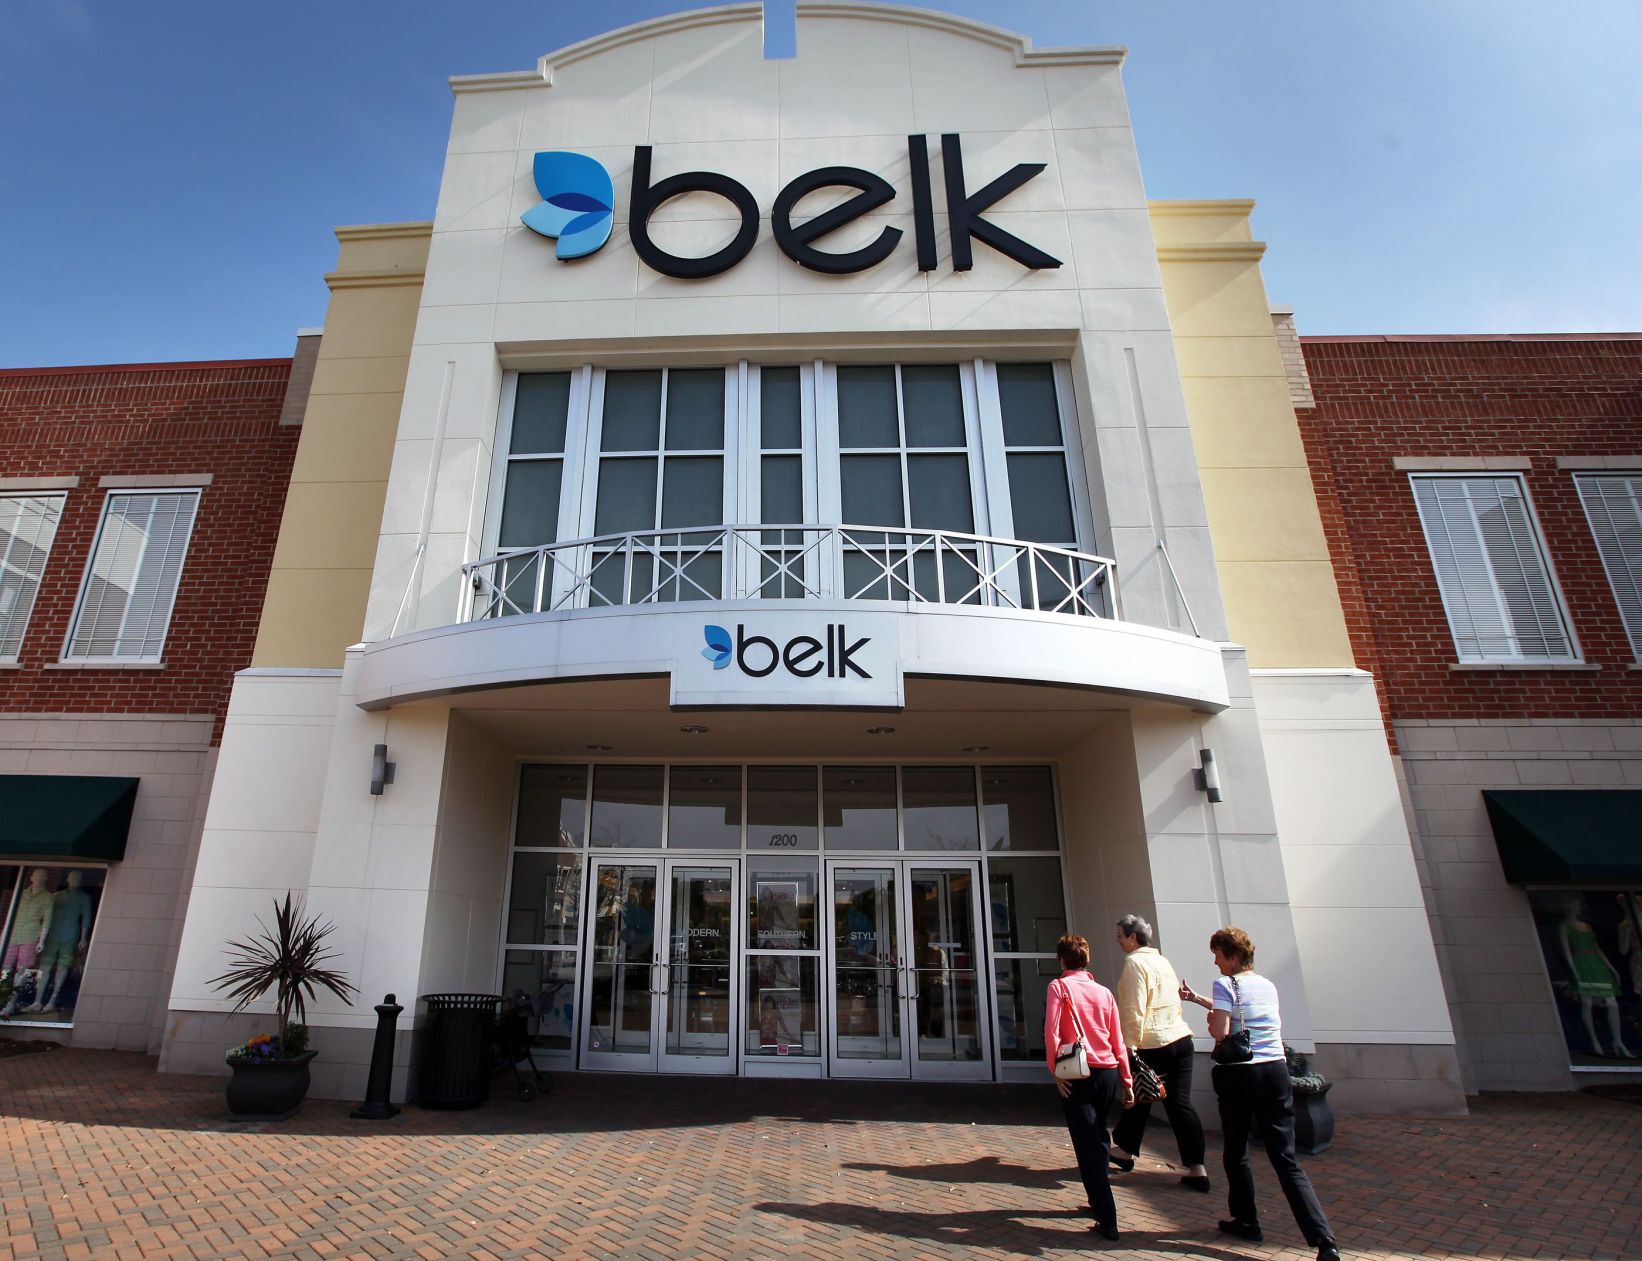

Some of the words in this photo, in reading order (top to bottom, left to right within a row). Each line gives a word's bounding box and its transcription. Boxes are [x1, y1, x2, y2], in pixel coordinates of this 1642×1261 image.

[629, 133, 1064, 279] belk
[737, 624, 873, 679] belk
[769, 834, 798, 847] 1200
